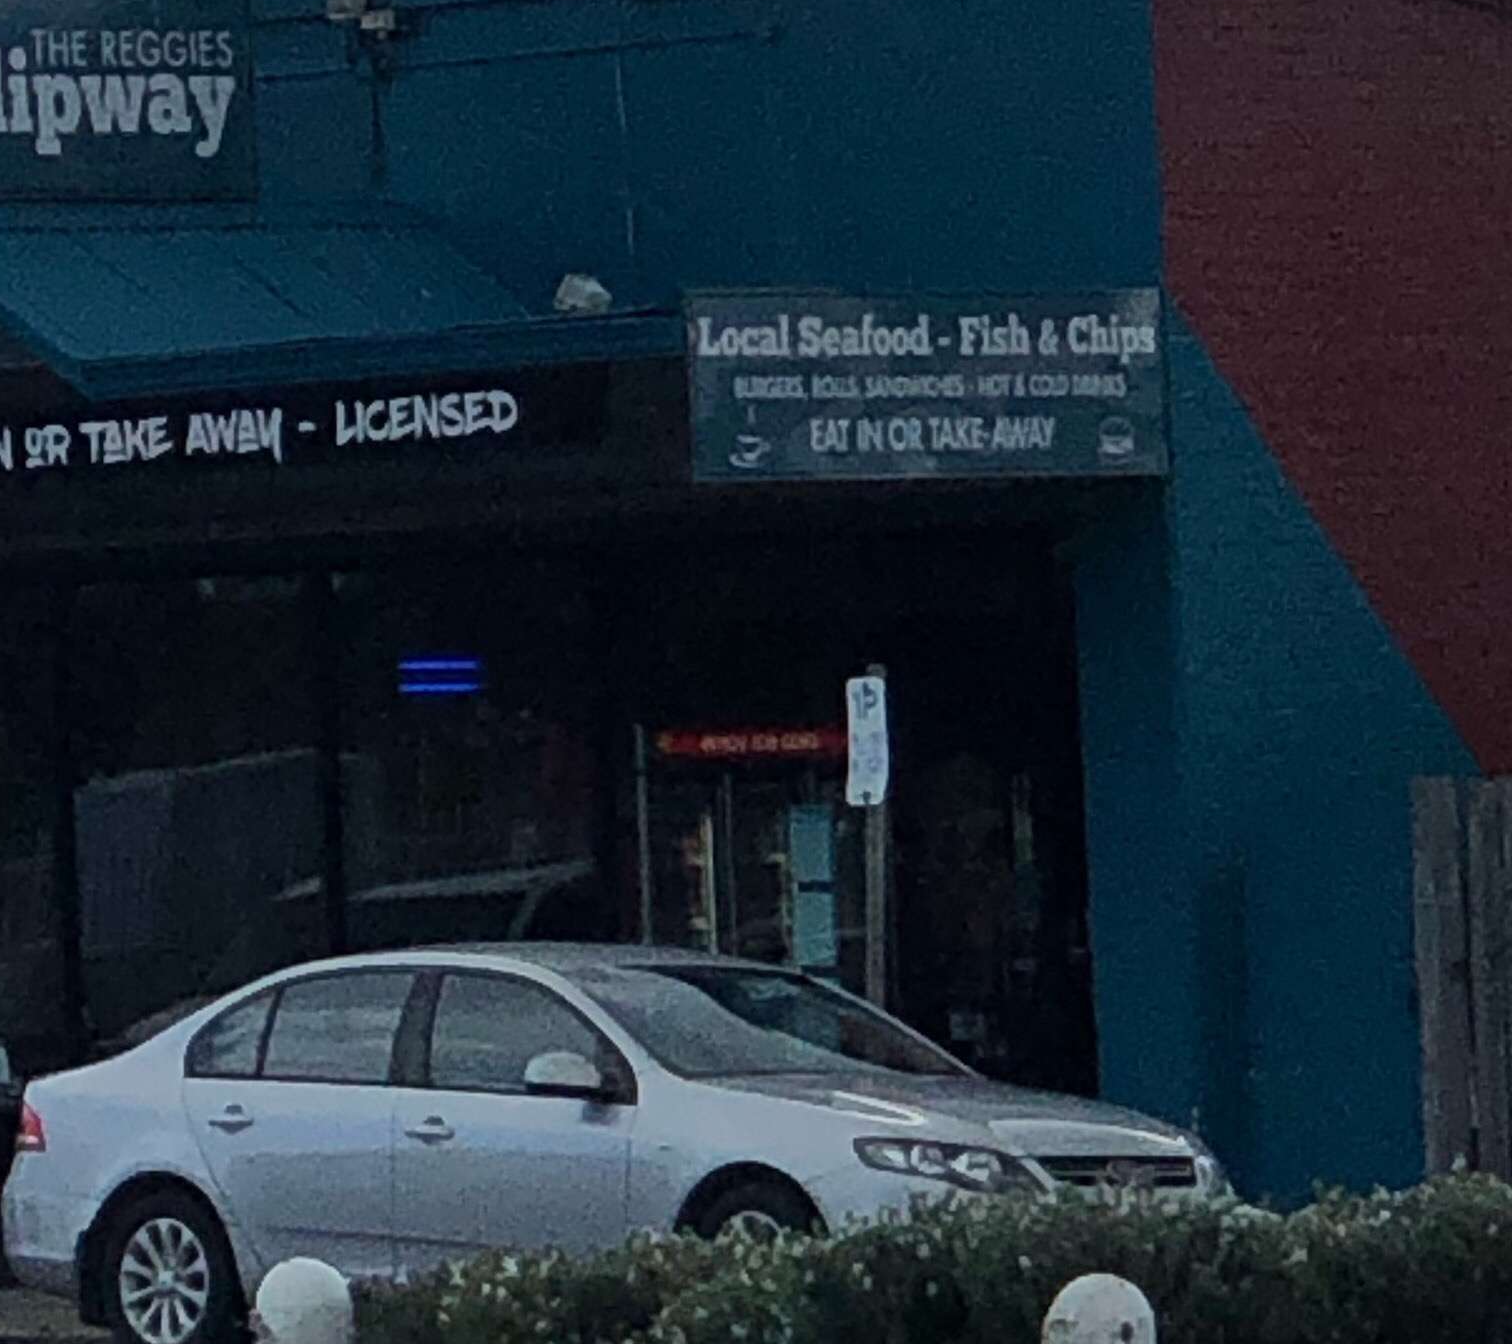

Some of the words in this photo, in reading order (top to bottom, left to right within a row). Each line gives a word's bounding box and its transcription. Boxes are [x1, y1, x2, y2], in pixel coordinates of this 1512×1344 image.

[30, 29, 88, 67] THE
[100, 28, 234, 68] REGGIES
[696, 315, 791, 357] Local
[798, 313, 932, 357] Seafood
[958, 312, 1031, 356] Fish
[1037, 319, 1059, 356] &
[1066, 313, 1156, 362] Chips
[25, 423, 71, 469] OR
[79, 415, 173, 465] TAKE
[185, 406, 283, 464] AWAY
[334, 389, 518, 447] LICENSED
[808, 417, 850, 452] EAT
[856, 416, 887, 452] IN
[888, 417, 923, 452] OR
